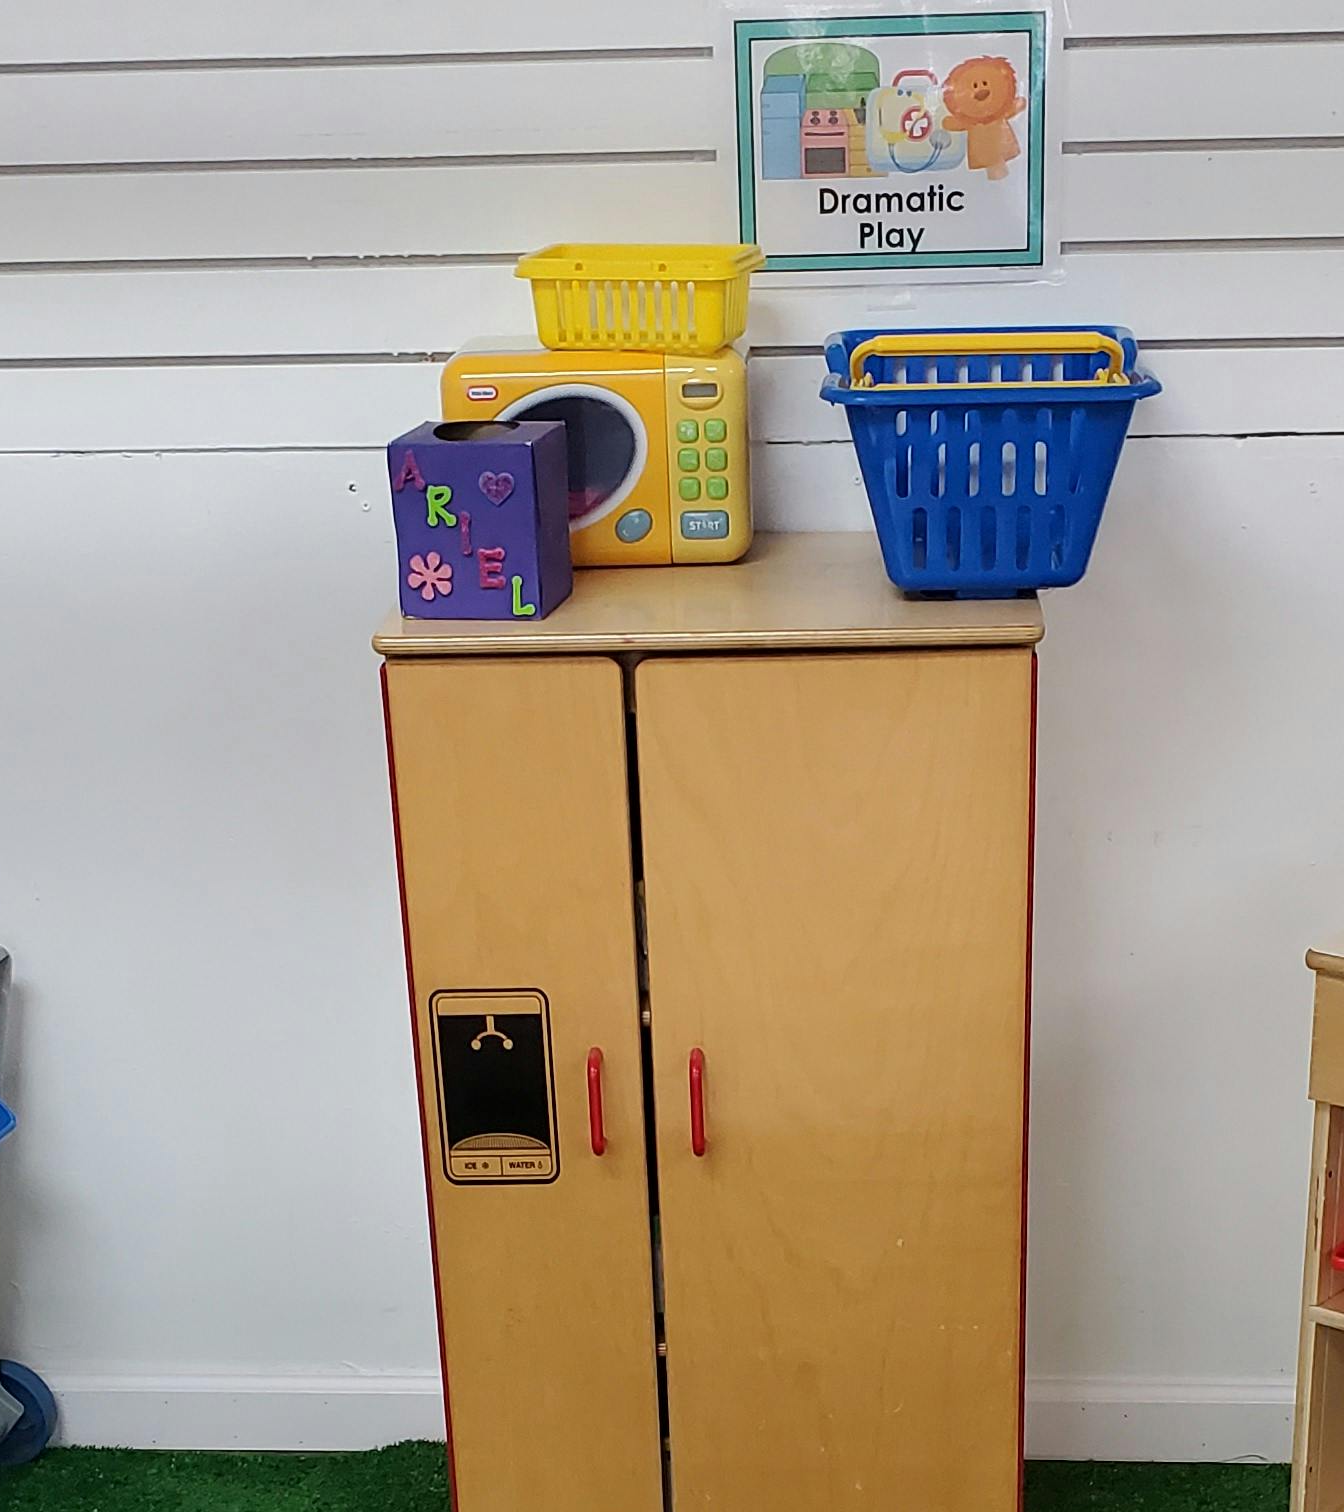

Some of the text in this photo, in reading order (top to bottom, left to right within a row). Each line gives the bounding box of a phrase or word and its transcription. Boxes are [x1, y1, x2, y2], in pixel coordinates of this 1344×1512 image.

[819, 184, 965, 214] Dramatic
[860, 222, 925, 252] Play
[509, 1161, 536, 1169] WATER
